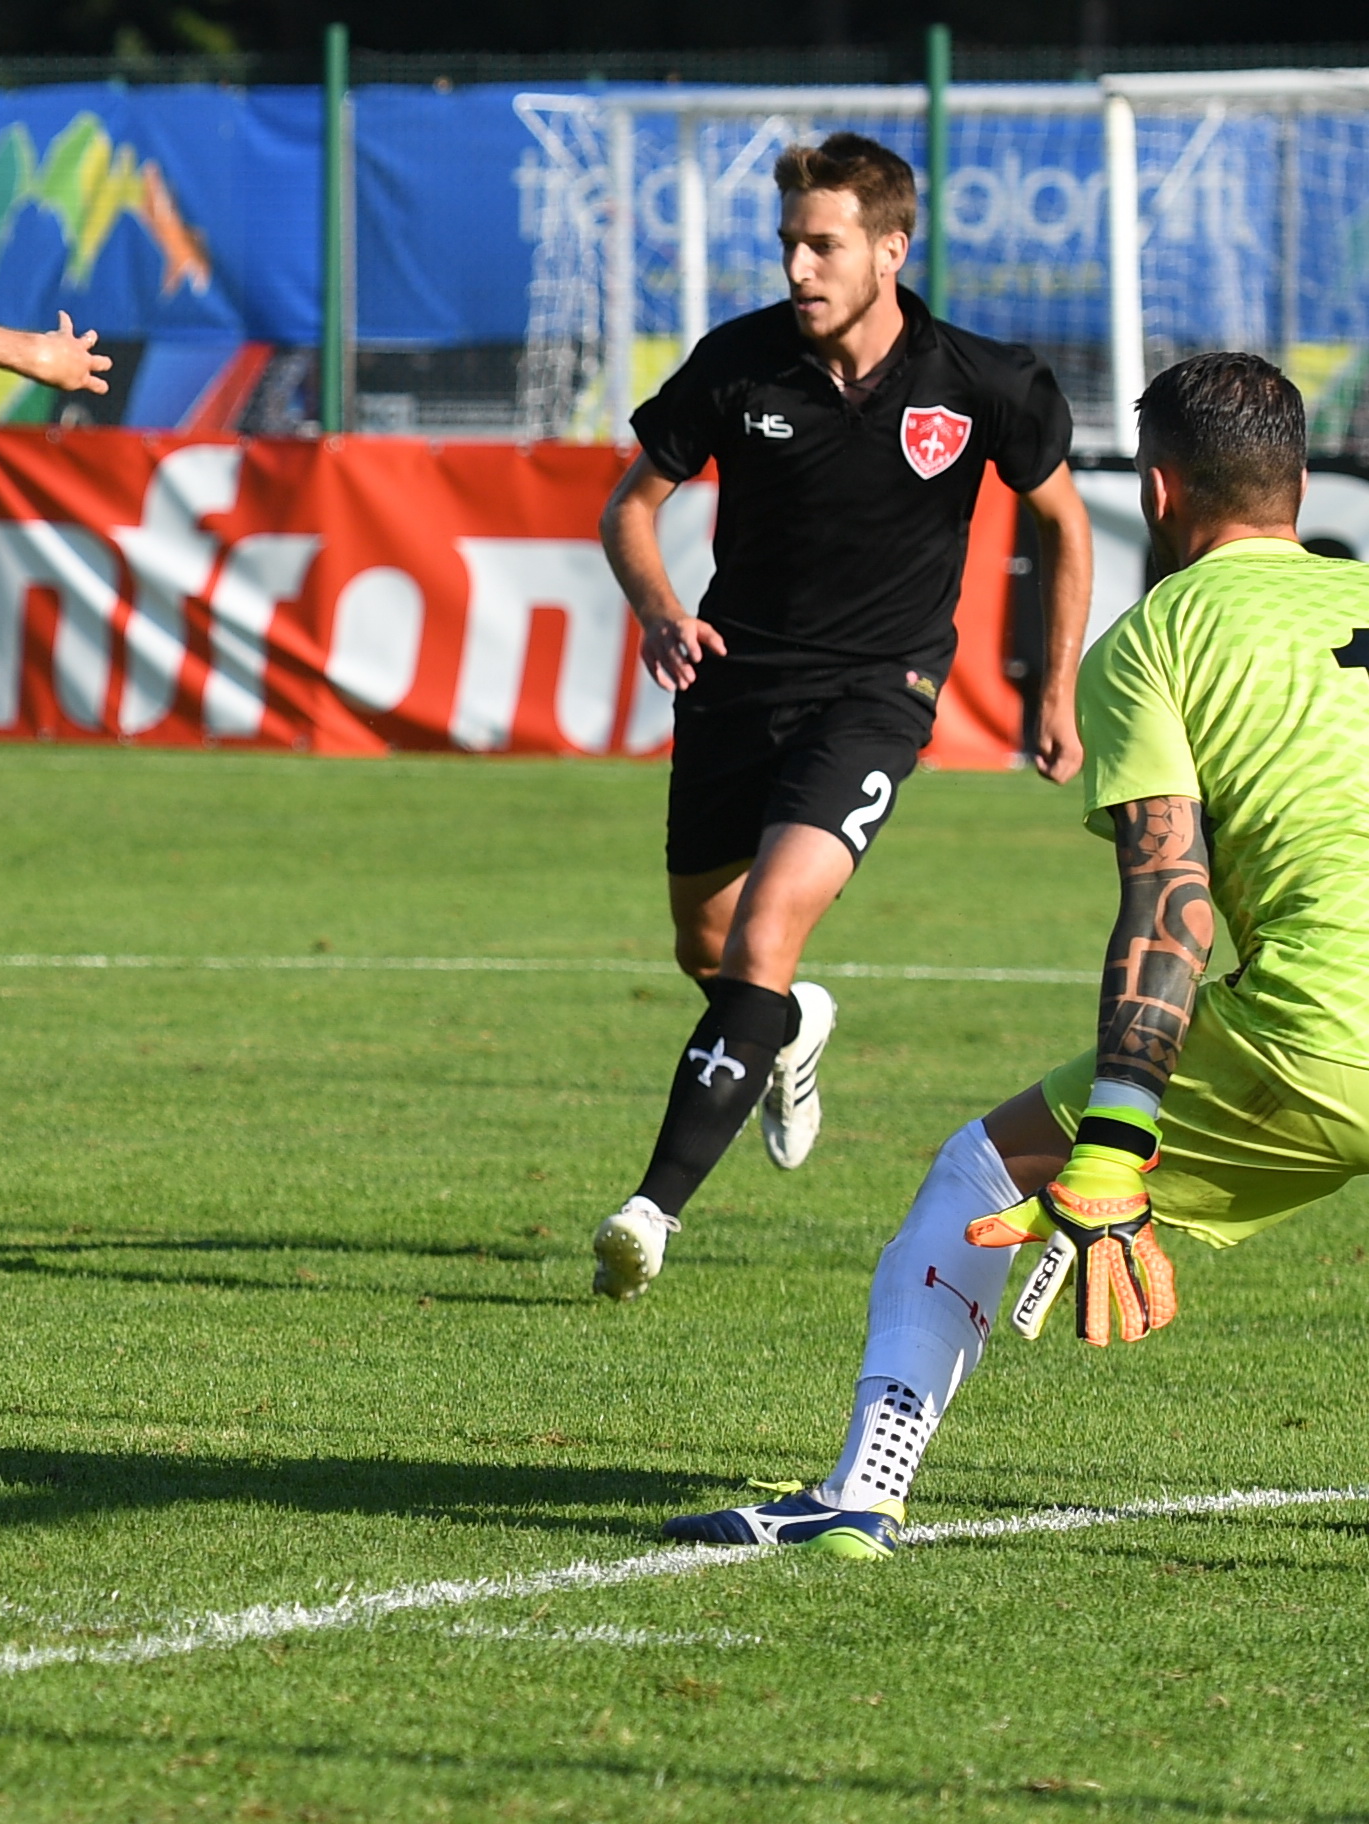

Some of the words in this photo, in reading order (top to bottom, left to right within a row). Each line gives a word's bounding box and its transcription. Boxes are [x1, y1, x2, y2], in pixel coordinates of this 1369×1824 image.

[742, 411, 794, 439] HS
[840, 770, 893, 852] 2
[1016, 1246, 1065, 1326] reusch
